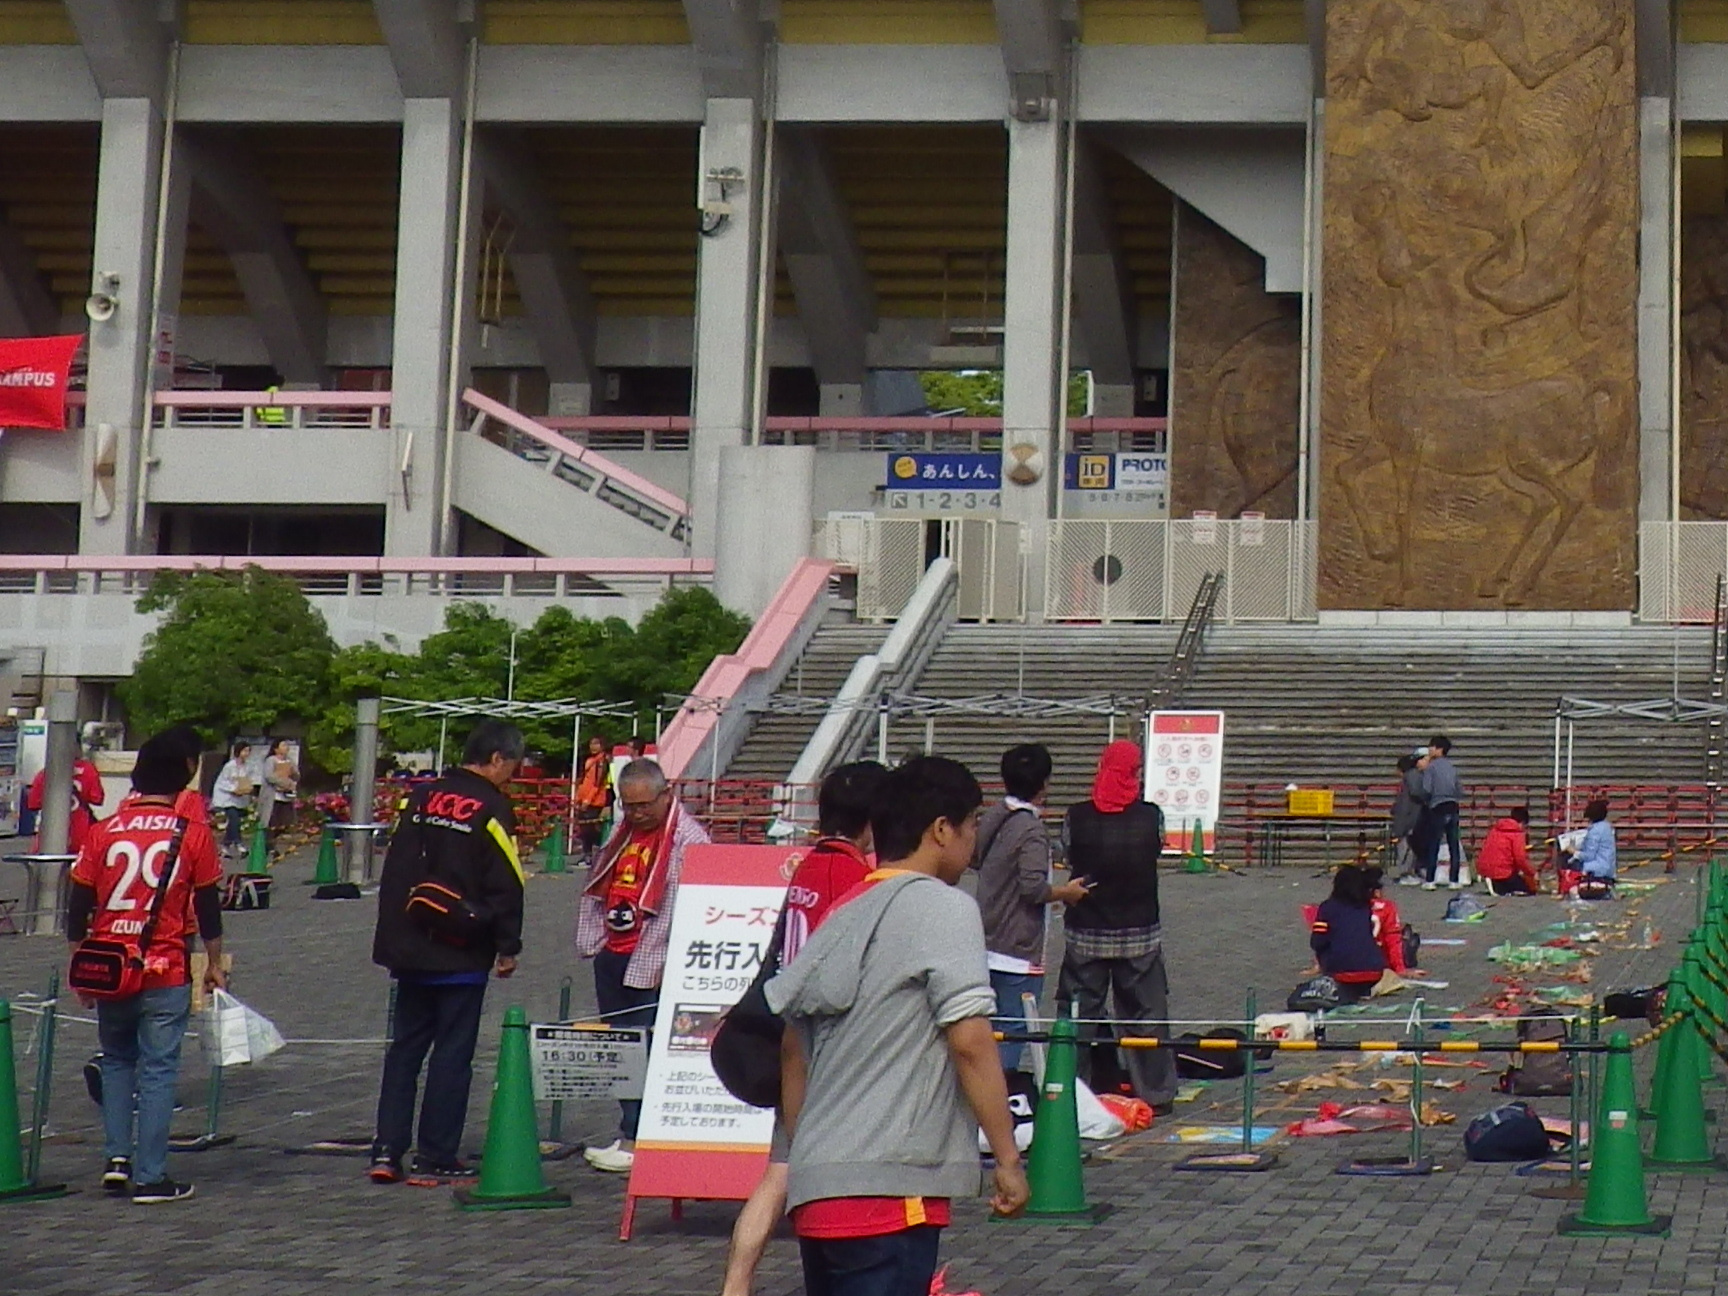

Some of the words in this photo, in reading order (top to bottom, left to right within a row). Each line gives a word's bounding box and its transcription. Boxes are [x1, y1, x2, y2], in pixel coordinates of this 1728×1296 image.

[922, 464, 996, 480] あんしん、
[105, 840, 181, 912] 29
[684, 940, 768, 971] 先行入
